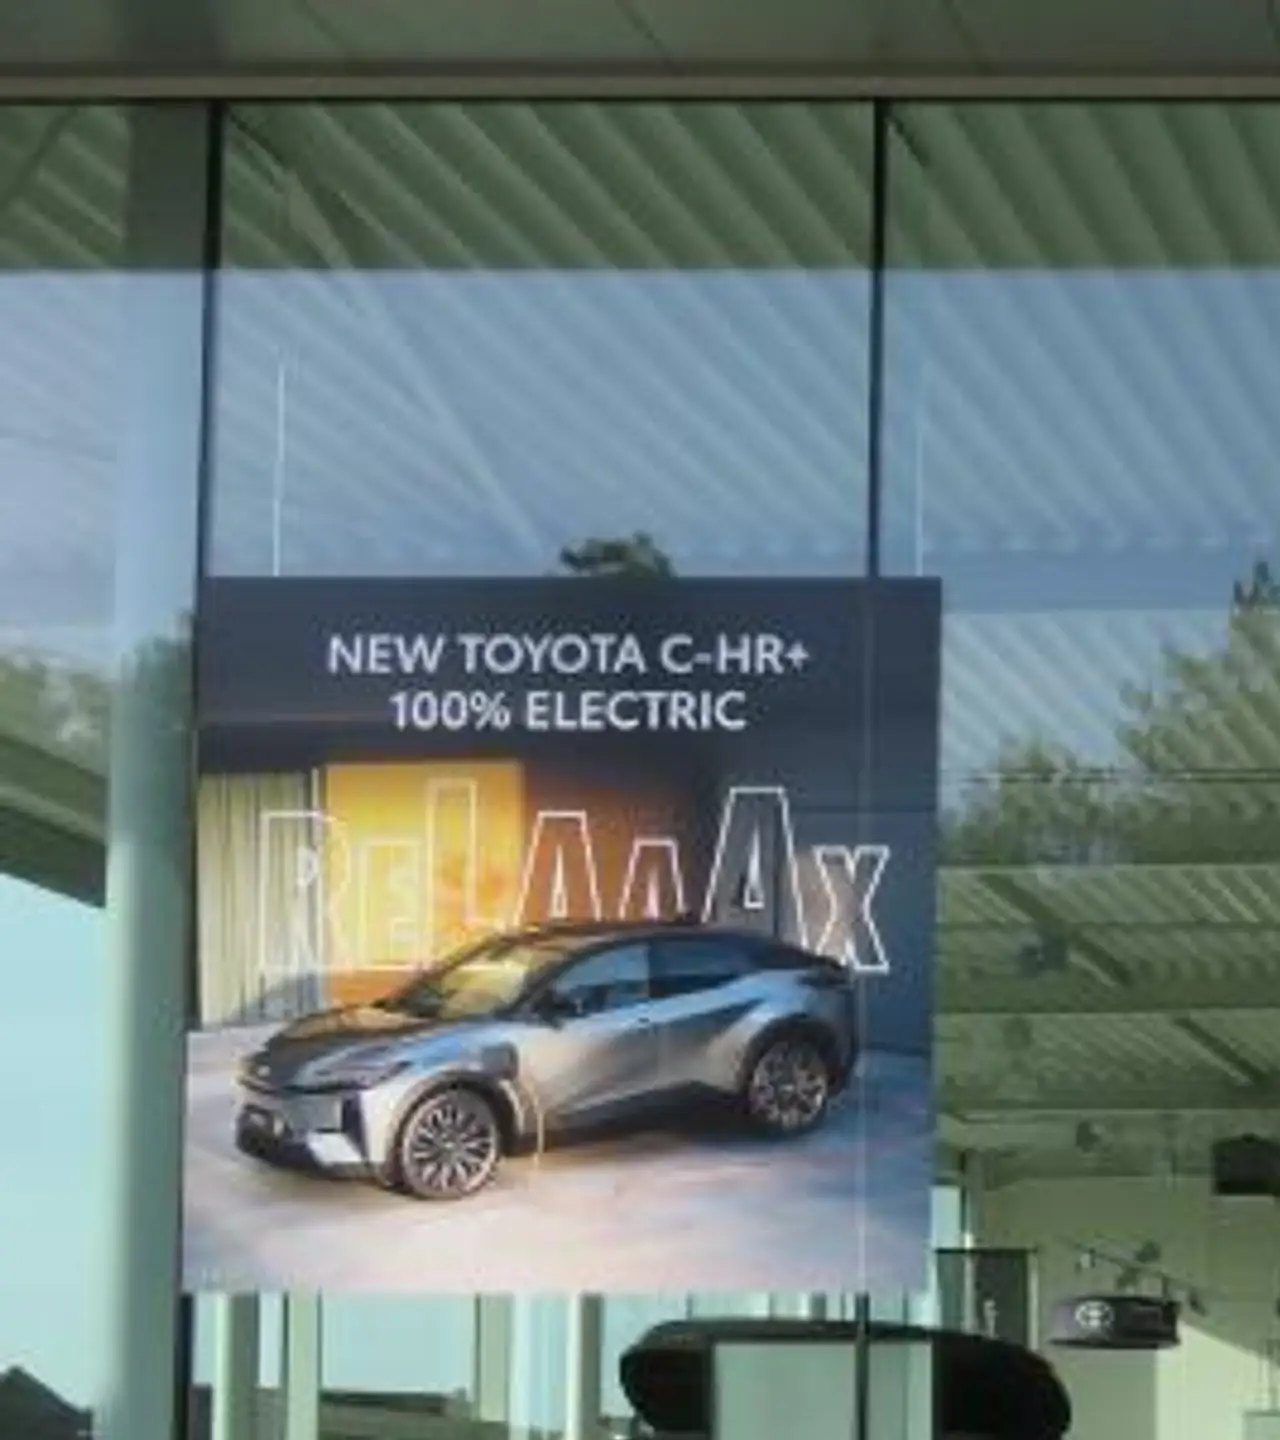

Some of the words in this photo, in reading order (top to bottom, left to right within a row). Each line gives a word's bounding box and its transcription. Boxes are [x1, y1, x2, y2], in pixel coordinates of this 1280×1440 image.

[328, 633, 445, 675] NEW
[457, 633, 648, 675] TOYOTA
[660, 633, 811, 675] C-HR+
[390, 690, 511, 731] 100%
[526, 690, 748, 731] ELECTRIC
